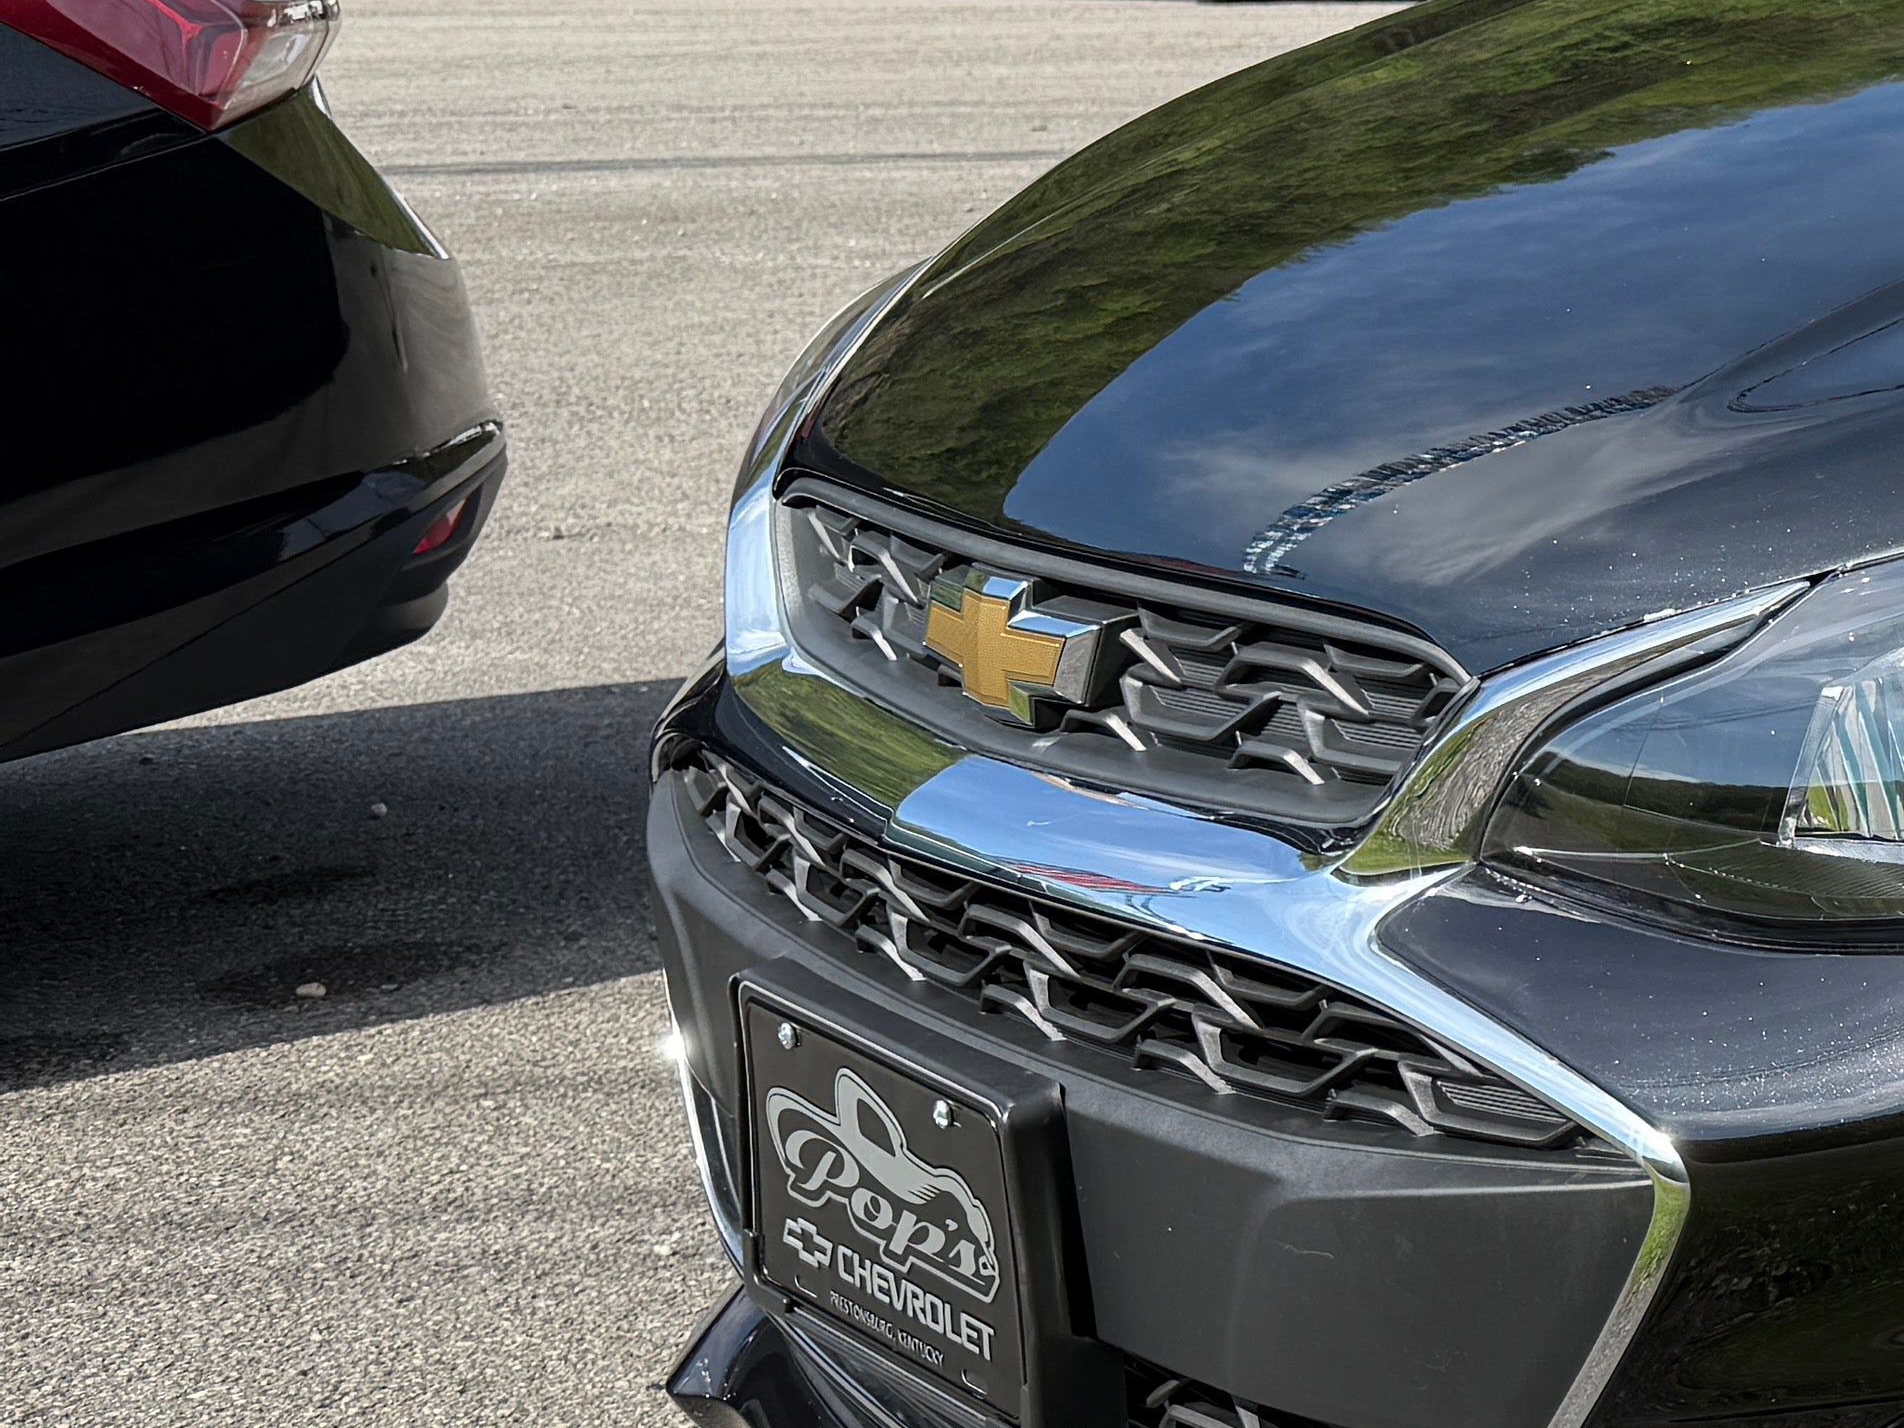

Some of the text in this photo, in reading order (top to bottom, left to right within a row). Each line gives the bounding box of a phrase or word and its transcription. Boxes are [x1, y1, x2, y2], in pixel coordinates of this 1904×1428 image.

[783, 1129, 997, 1277] Pop's
[837, 1245, 995, 1361] CHEVROLET
[897, 1325, 945, 1367] KENTUCKY
